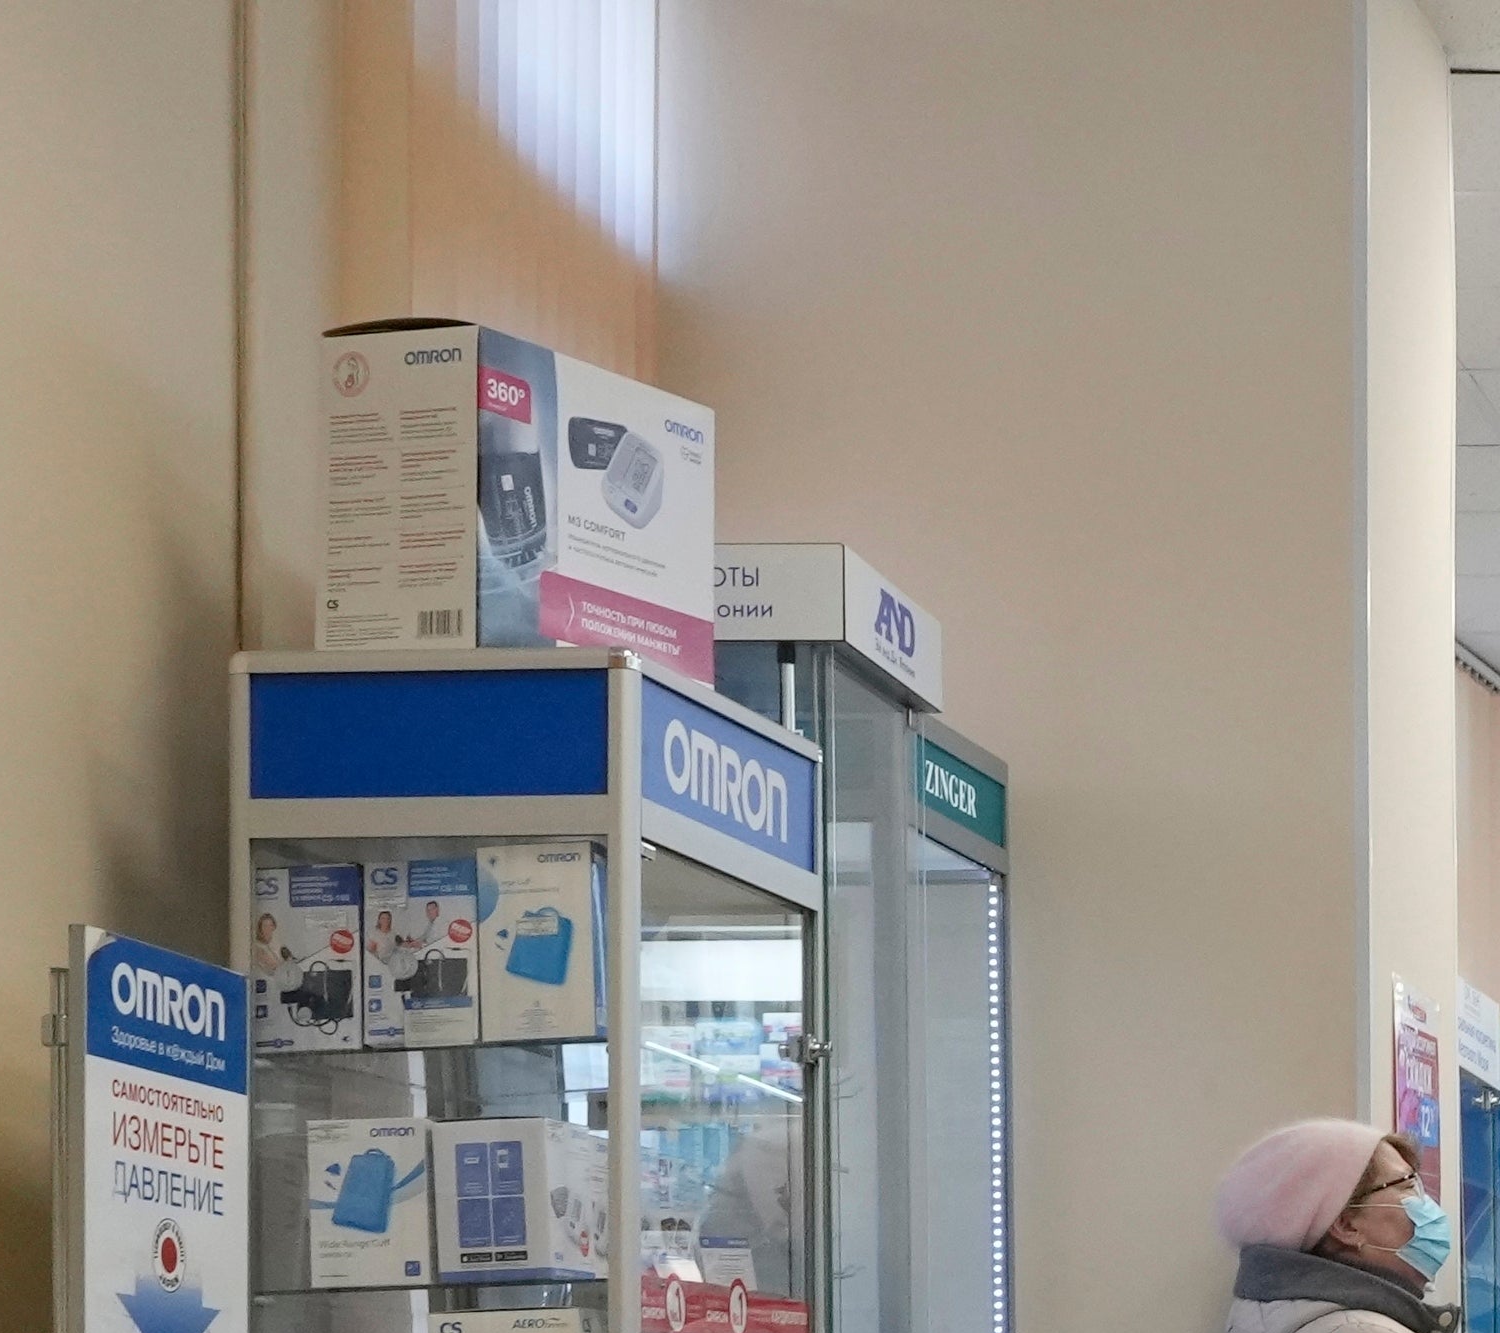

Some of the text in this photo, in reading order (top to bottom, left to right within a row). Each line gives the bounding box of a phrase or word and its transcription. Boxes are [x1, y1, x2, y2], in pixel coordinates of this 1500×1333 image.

[404, 348, 462, 366] OMRON
[487, 378, 526, 407] 360°
[664, 419, 704, 445] OMRON
[524, 486, 538, 528] OMRON
[583, 519, 626, 542] COMFORT
[713, 566, 760, 588] ОТЫ
[326, 600, 340, 610] CS
[717, 604, 774, 618] онии
[663, 718, 788, 844] OMRON
[925, 759, 978, 819] ZINGER
[537, 852, 582, 864] OMRON
[370, 866, 399, 887] CS
[111, 962, 226, 1042] OMRON
[112, 1079, 224, 1123] САМОСТОЯТЕЛЬНО
[113, 1111, 225, 1170] ИЗМЕРЬТЕ
[370, 1126, 415, 1138] OMRON
[113, 1160, 224, 1216] ДАВЛЕНИЕ
